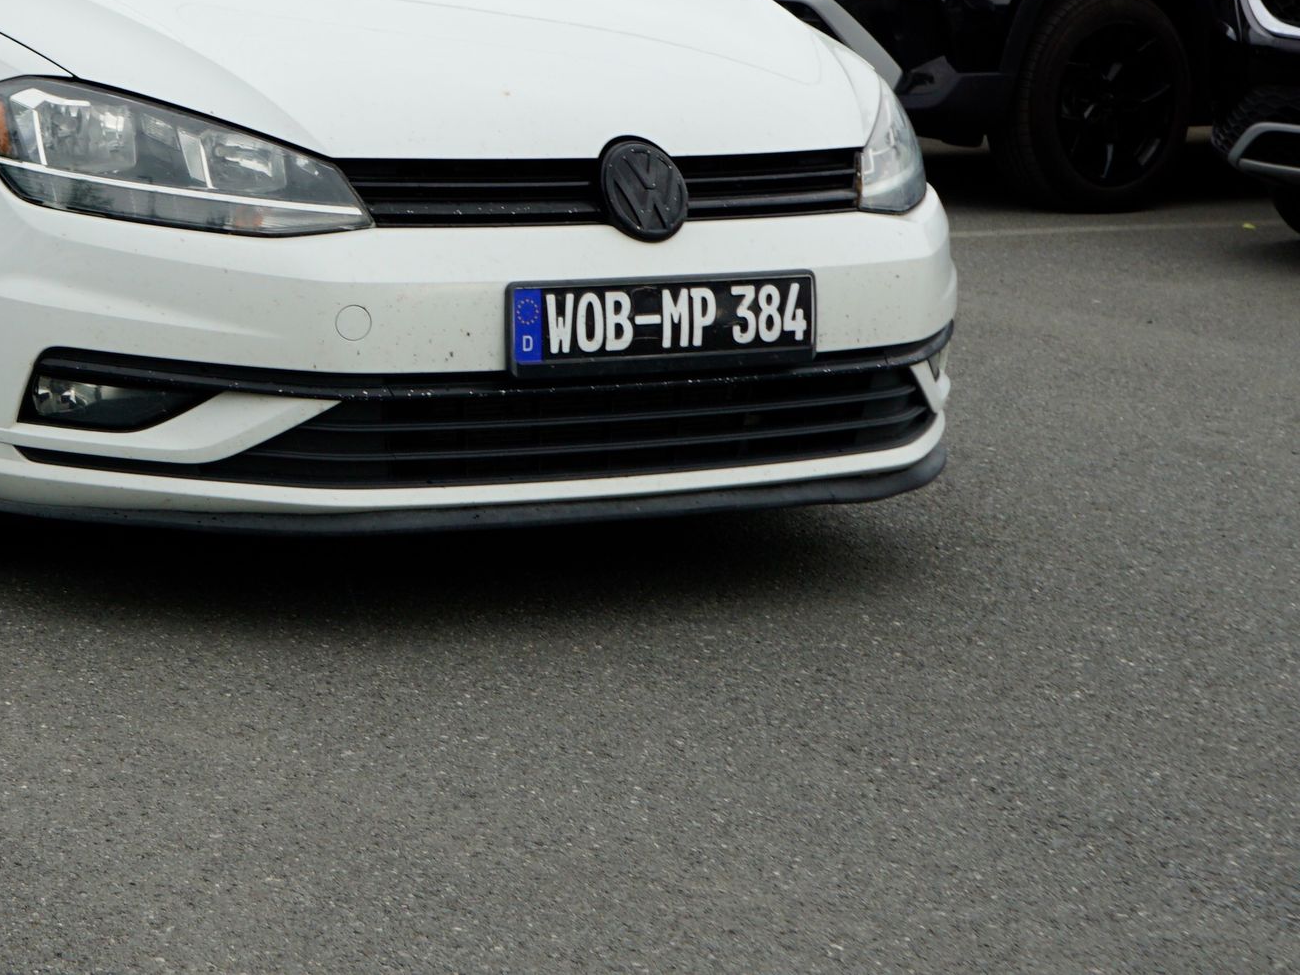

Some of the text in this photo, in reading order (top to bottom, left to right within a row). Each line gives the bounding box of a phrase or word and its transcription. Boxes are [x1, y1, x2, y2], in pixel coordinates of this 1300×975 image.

[545, 282, 807, 354] WOB-MP 384
[521, 335, 534, 352] D
